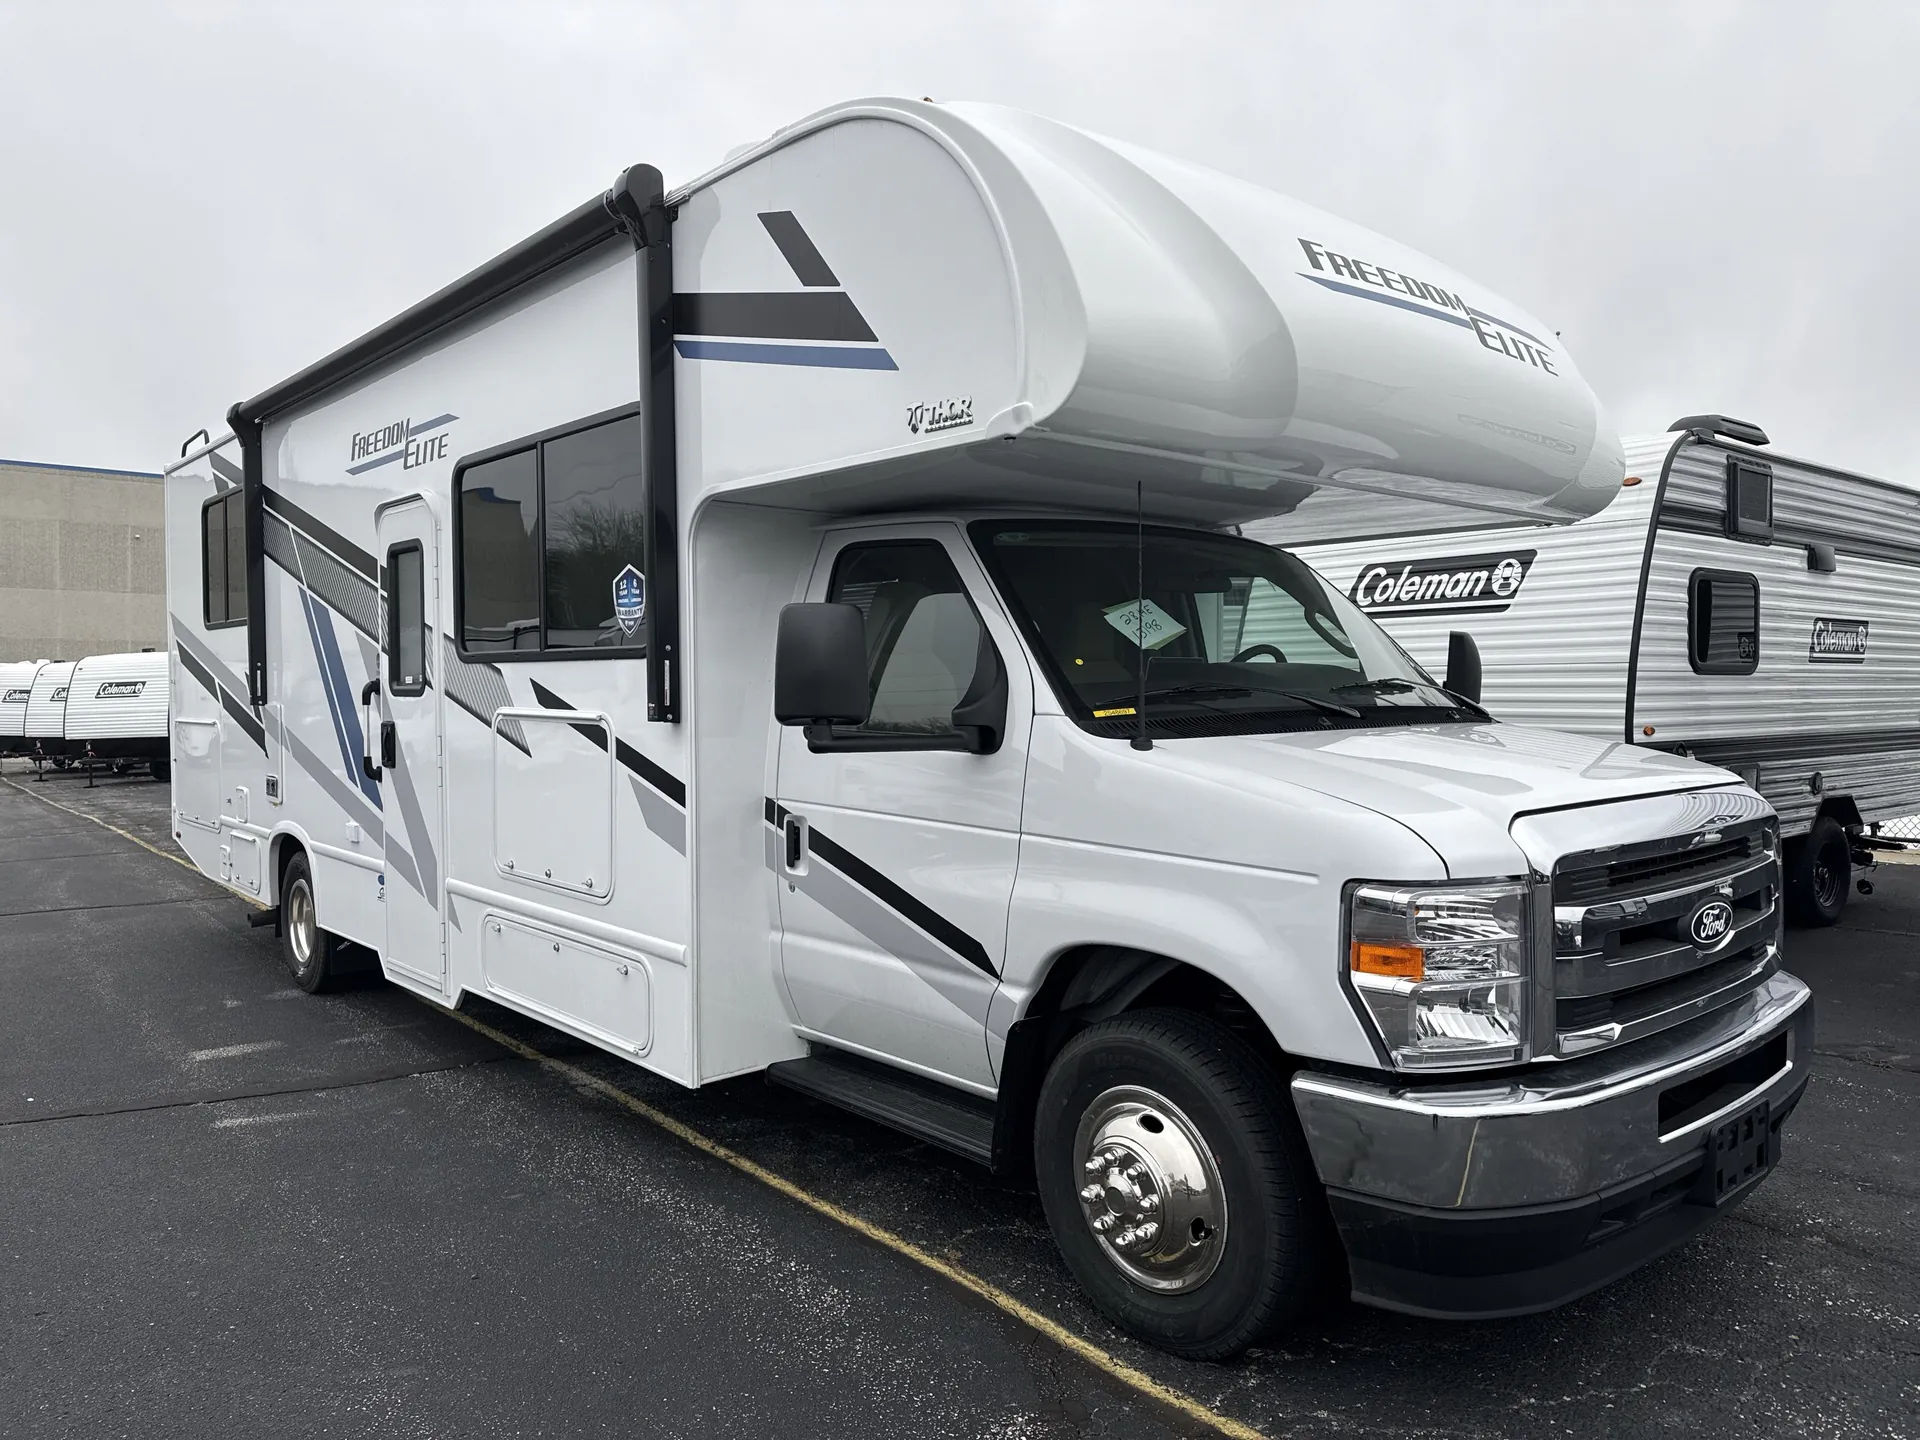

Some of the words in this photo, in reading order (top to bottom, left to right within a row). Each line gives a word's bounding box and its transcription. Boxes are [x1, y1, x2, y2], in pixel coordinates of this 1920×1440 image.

[1297, 237, 1471, 316] FREEDOM
[1469, 316, 1559, 377] ELITE
[924, 395, 973, 426] THOR
[351, 417, 410, 462] FREEDOM
[403, 432, 449, 470] ELITE
[1356, 565, 1490, 607] Coleman
[1814, 621, 1857, 652] Coleman
[99, 683, 136, 696] Coleman
[1700, 908, 1726, 938] Ford
